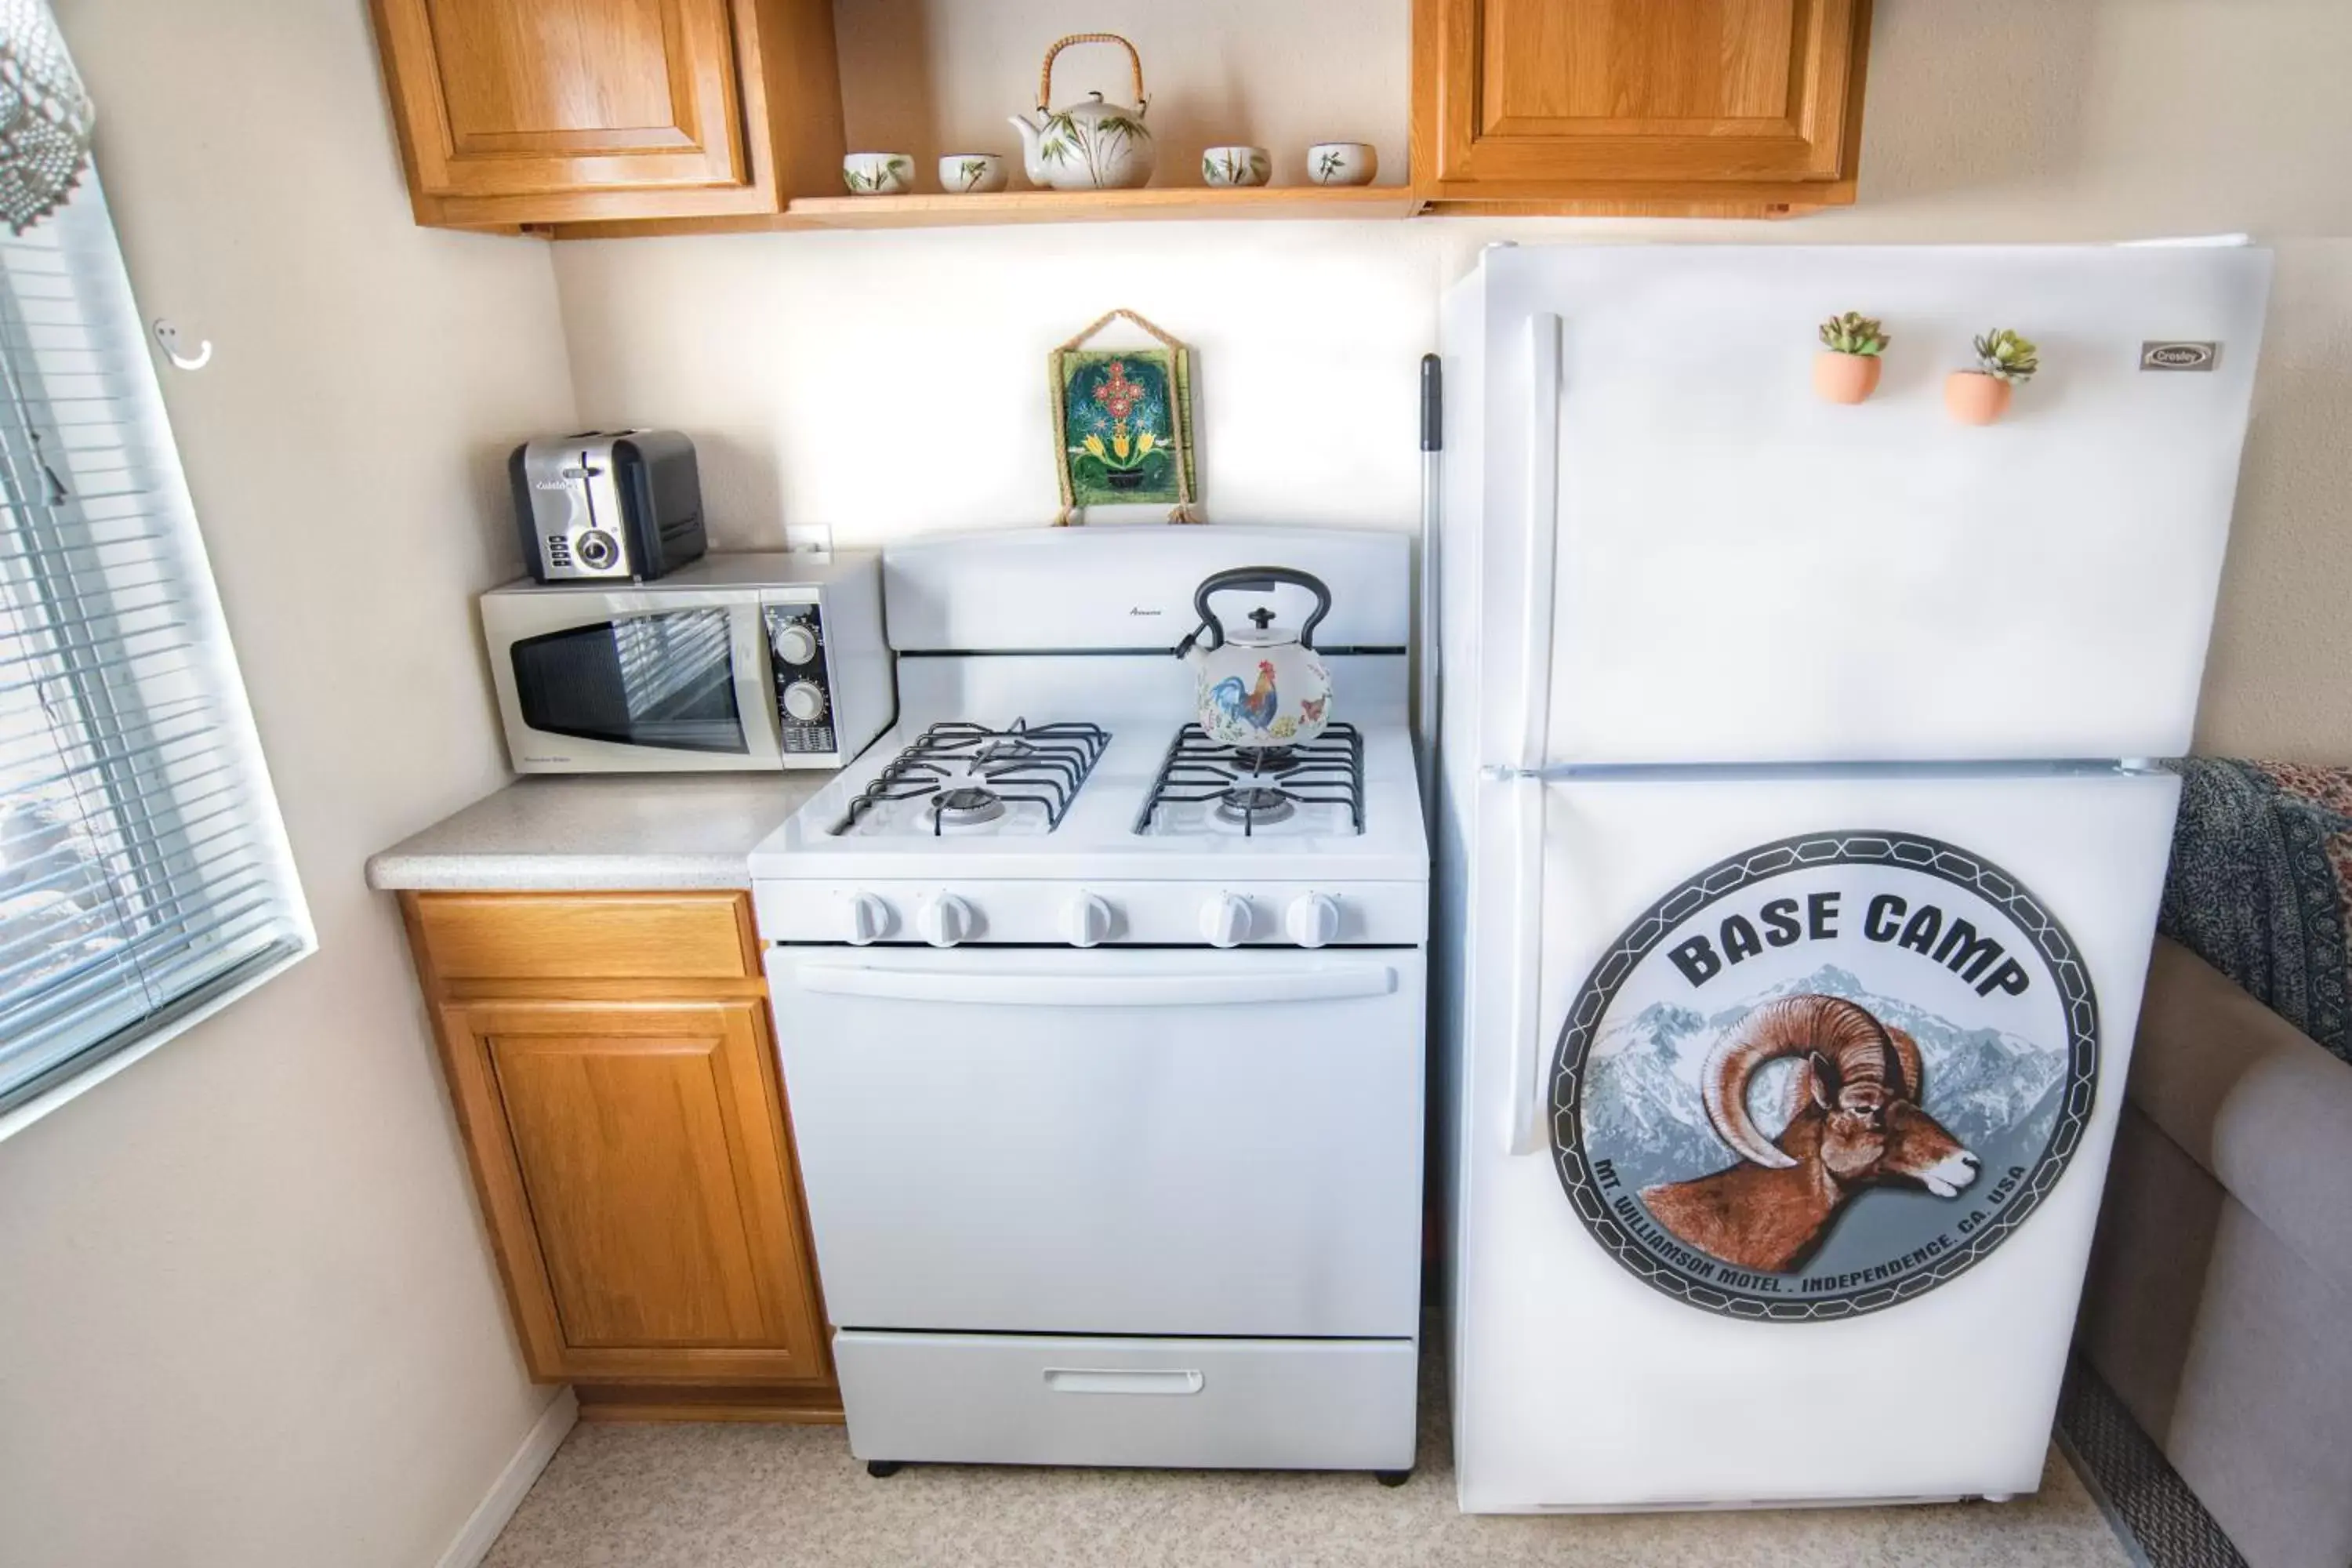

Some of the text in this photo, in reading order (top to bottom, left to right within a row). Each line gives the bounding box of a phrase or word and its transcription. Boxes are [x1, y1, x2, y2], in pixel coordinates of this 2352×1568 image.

[2157, 350, 2194, 364] Crosley
[1667, 891, 2029, 997] BASE CAMP
[1594, 1159, 1621, 1196] MT.
[1613, 1196, 1715, 1278] WILLIAMSON
[1717, 1268, 1781, 1293] MOTEL
[1986, 1165, 2027, 1205] USA
